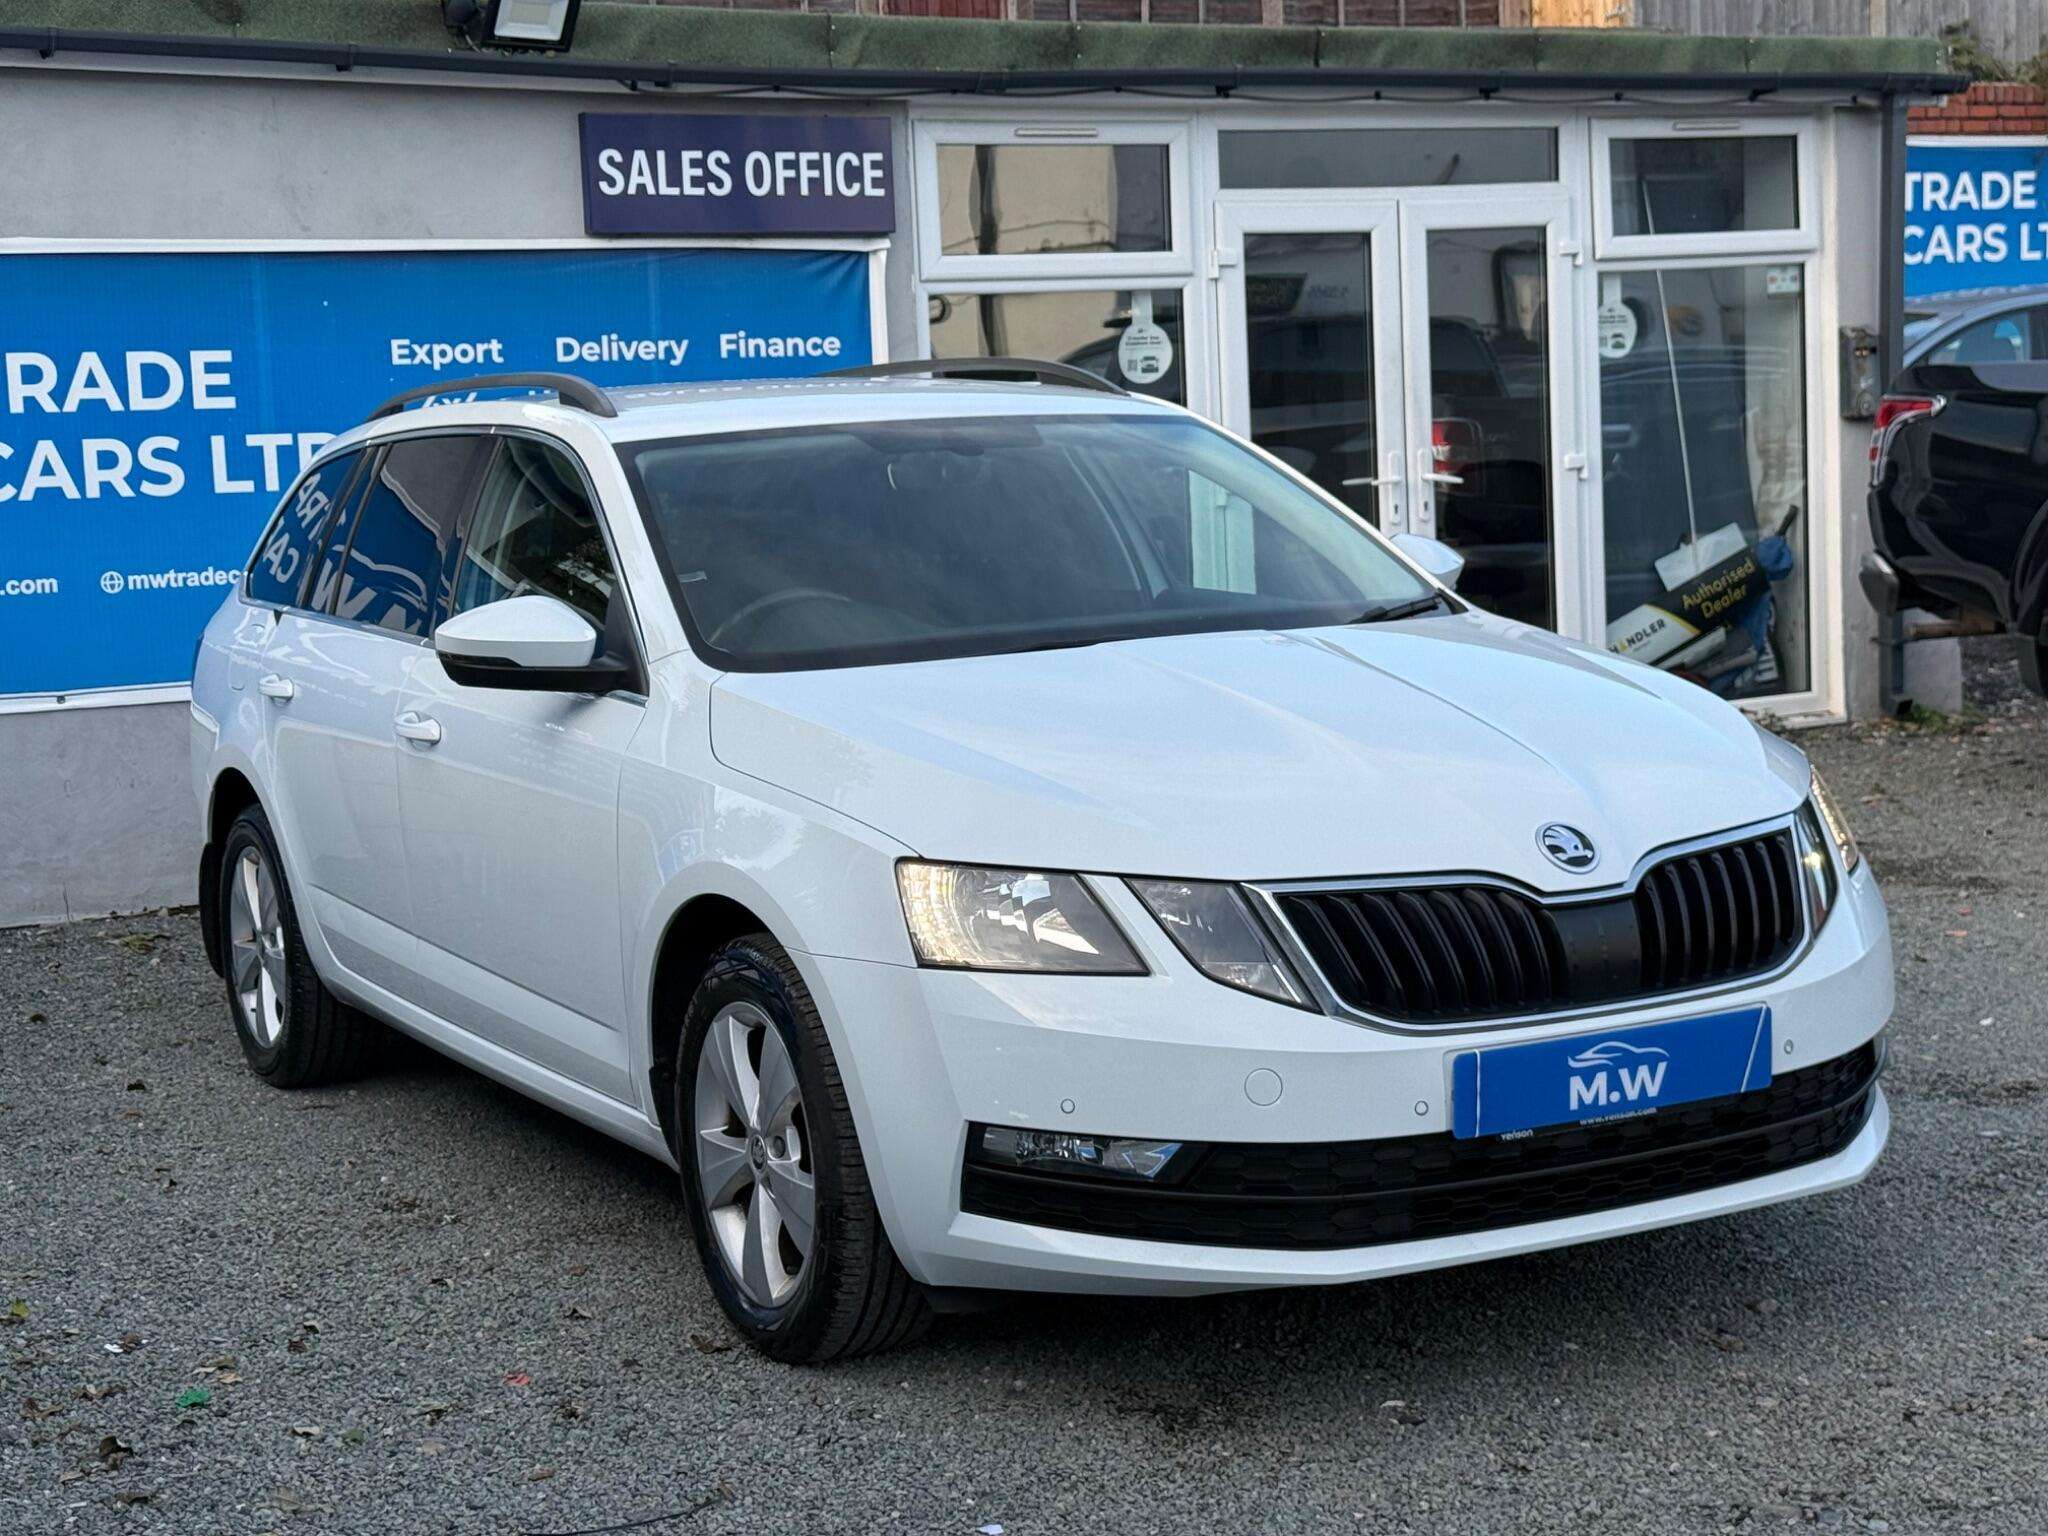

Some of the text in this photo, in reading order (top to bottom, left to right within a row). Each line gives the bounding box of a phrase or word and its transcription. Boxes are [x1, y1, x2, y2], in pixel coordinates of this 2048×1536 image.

[597, 147, 886, 198] SALES OFFICE
[1904, 170, 2038, 212] TRADE
[1904, 222, 2009, 266] CARS
[390, 330, 842, 371] Export Delivery Finance
[1682, 558, 1756, 611] Authorised
[1700, 584, 1747, 619] Dealer
[1568, 1060, 1670, 1111] M.W
